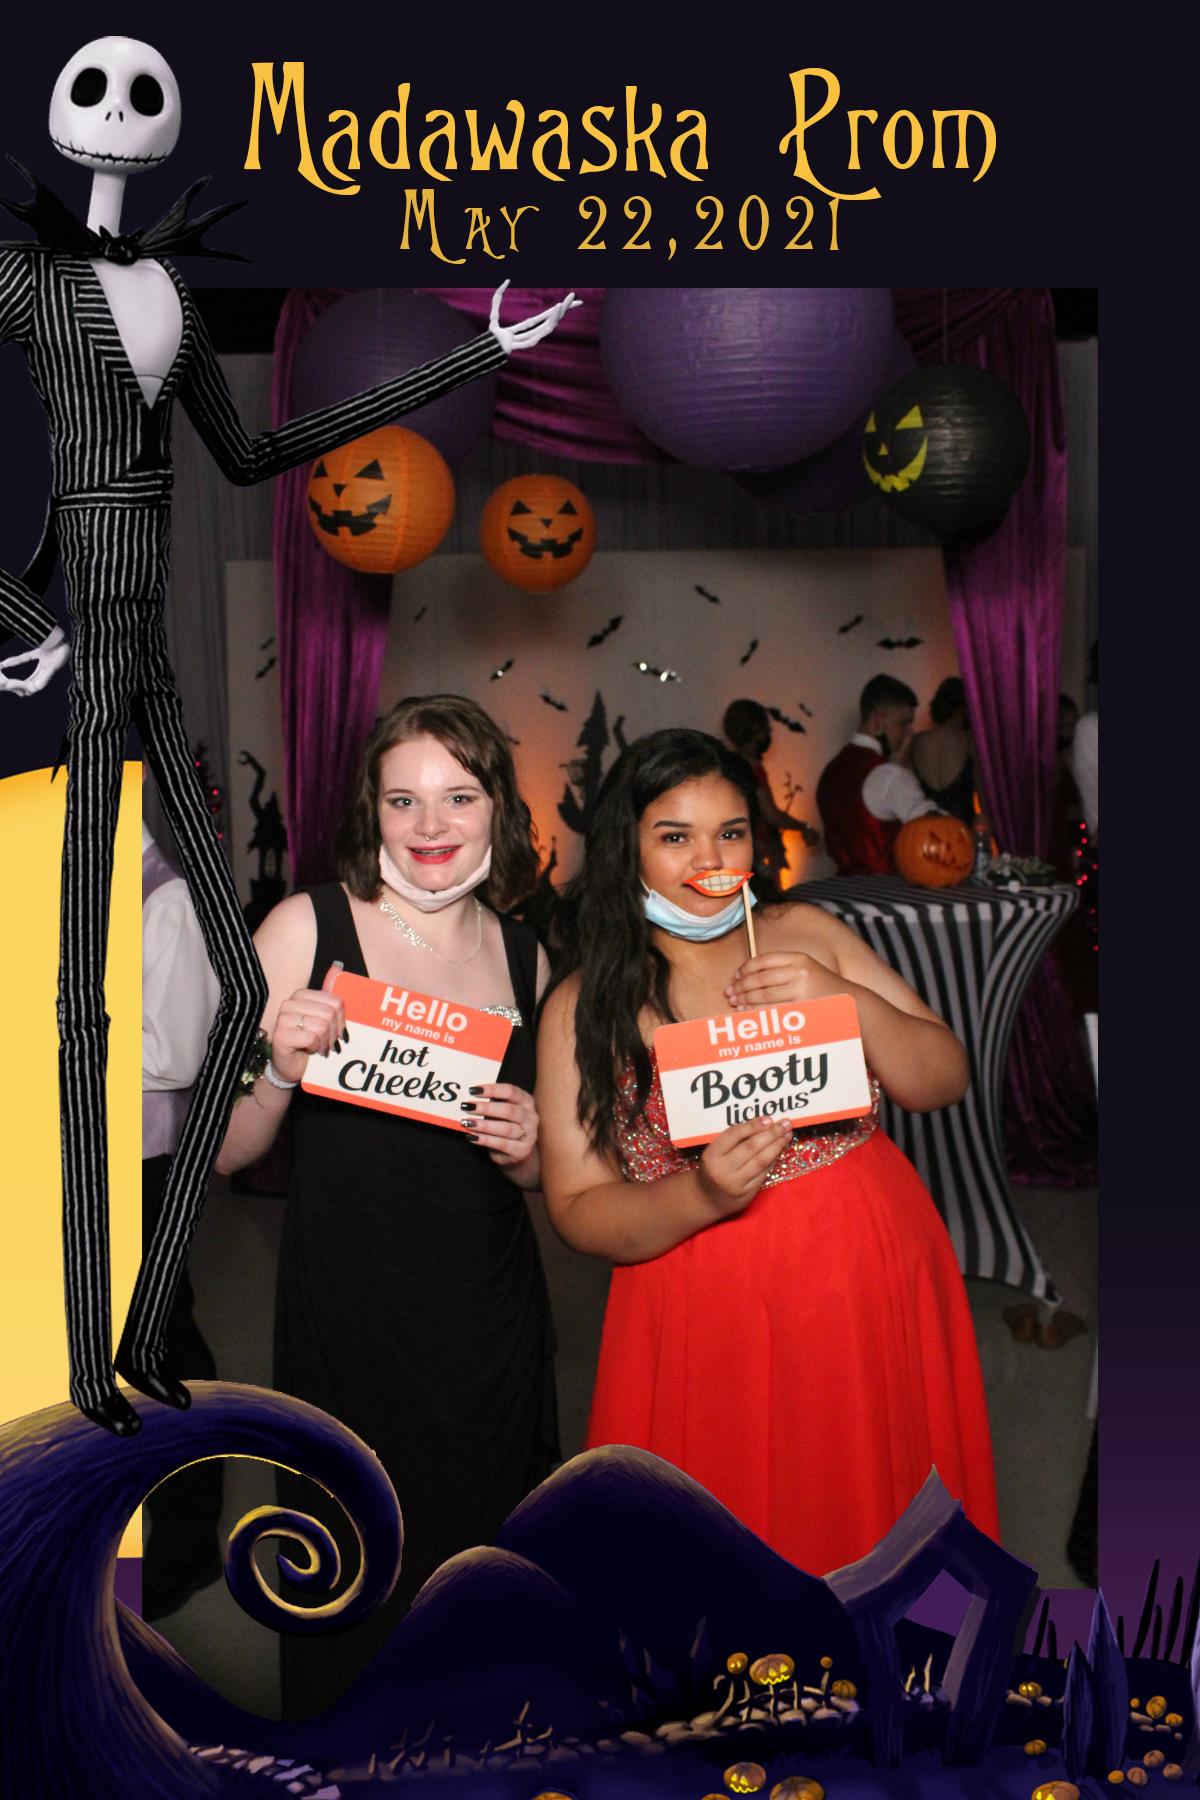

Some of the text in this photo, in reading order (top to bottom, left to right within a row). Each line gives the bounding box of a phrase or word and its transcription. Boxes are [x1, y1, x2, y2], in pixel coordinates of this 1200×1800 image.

[379, 986, 468, 1032] Hello
[707, 1007, 806, 1046] Hello
[381, 1016, 456, 1044] my name is
[718, 1033, 802, 1058] my name is
[379, 1039, 430, 1068] hot
[337, 1059, 462, 1103] Cheeks
[690, 1051, 829, 1110] Booty
[726, 1091, 811, 1127] licious
